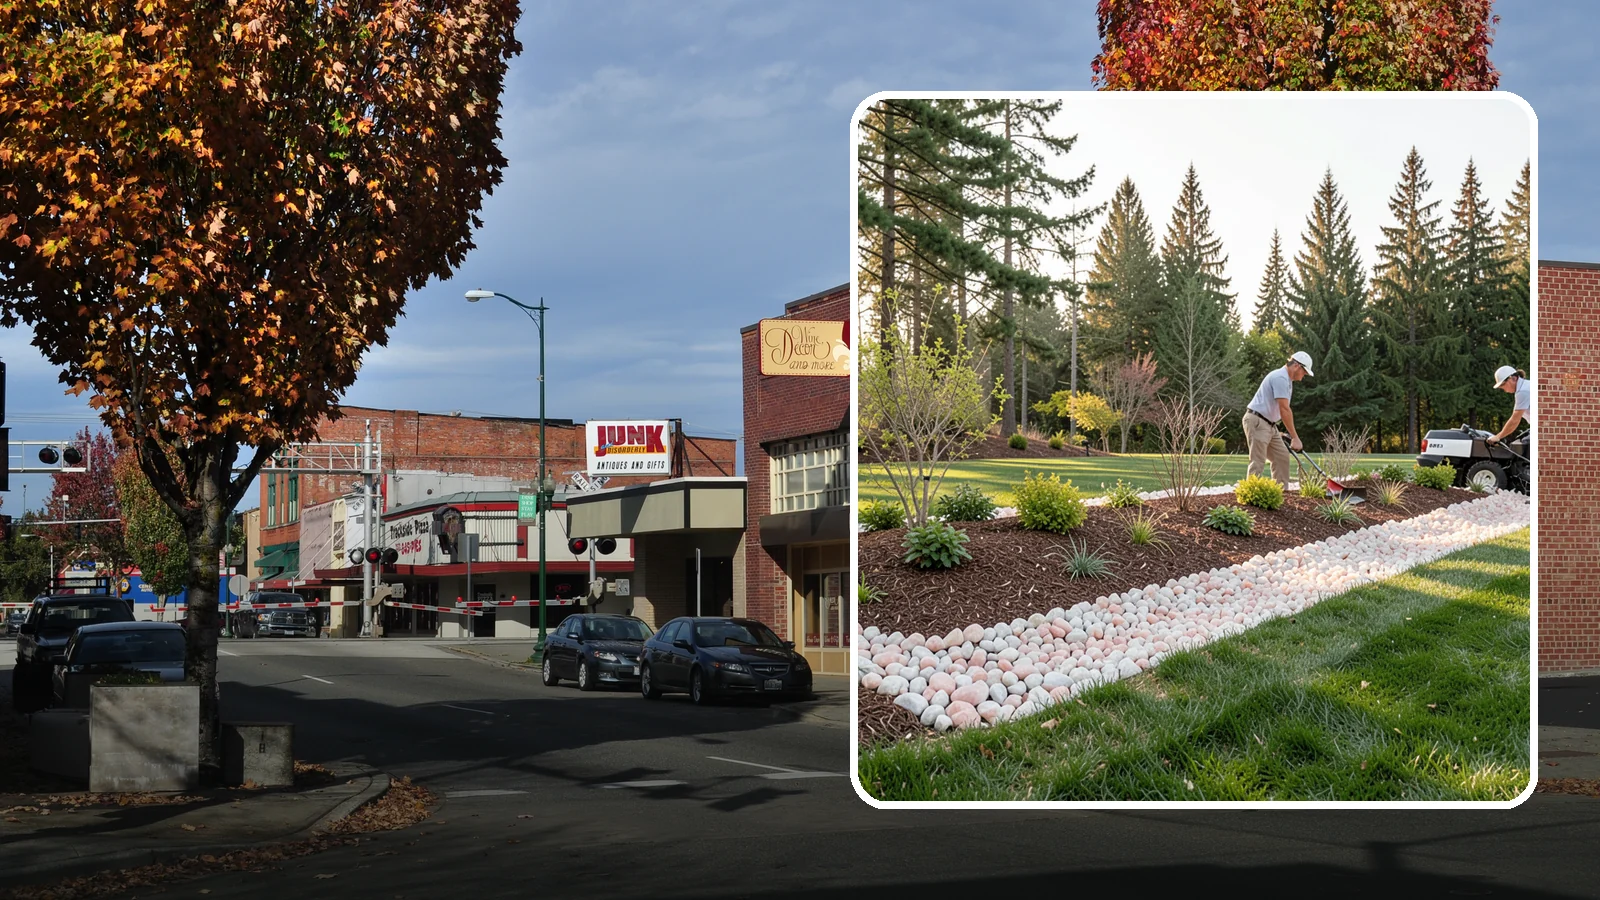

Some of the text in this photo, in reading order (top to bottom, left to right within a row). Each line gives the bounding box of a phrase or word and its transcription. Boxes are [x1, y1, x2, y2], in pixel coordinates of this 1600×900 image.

[595, 425, 665, 457] JUNK
[607, 446, 646, 454] DISORDERLY
[597, 460, 665, 470] ANTIQUES AND GIFTS
[414, 519, 429, 534] Pizza
